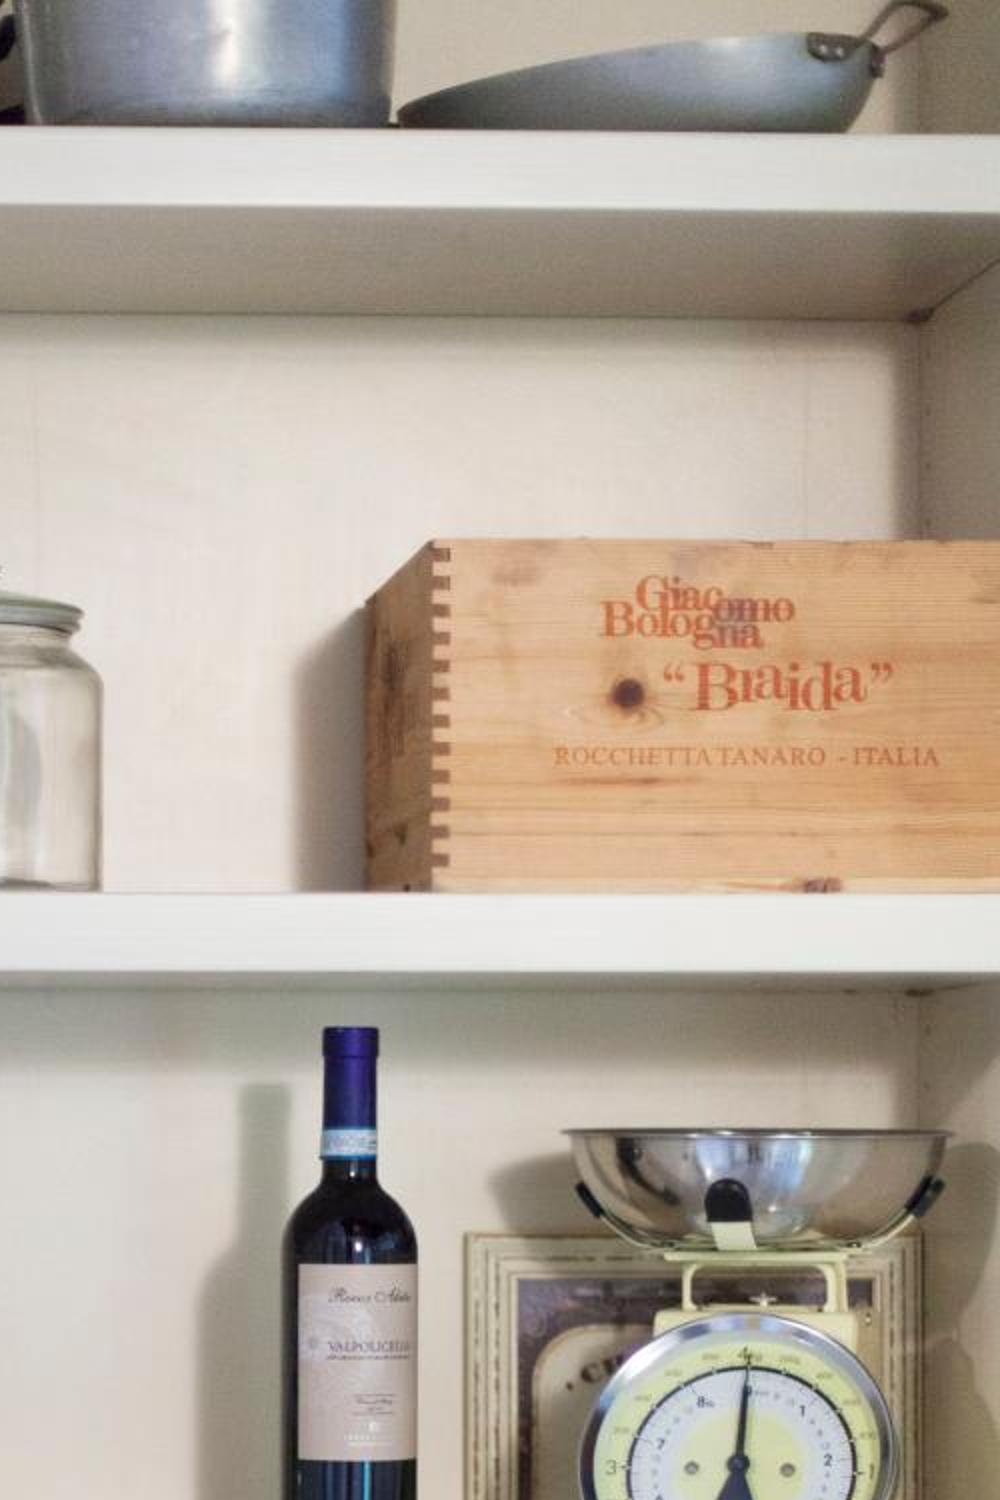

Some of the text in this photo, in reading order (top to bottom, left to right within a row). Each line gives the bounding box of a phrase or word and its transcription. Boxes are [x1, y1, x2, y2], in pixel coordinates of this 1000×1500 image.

[635, 575, 796, 623] Giacomo
[600, 598, 765, 650] Bologna
[553, 746, 712, 768] ROCCHETTA
[720, 746, 827, 768] TANARO
[853, 746, 941, 768] ITALIA
